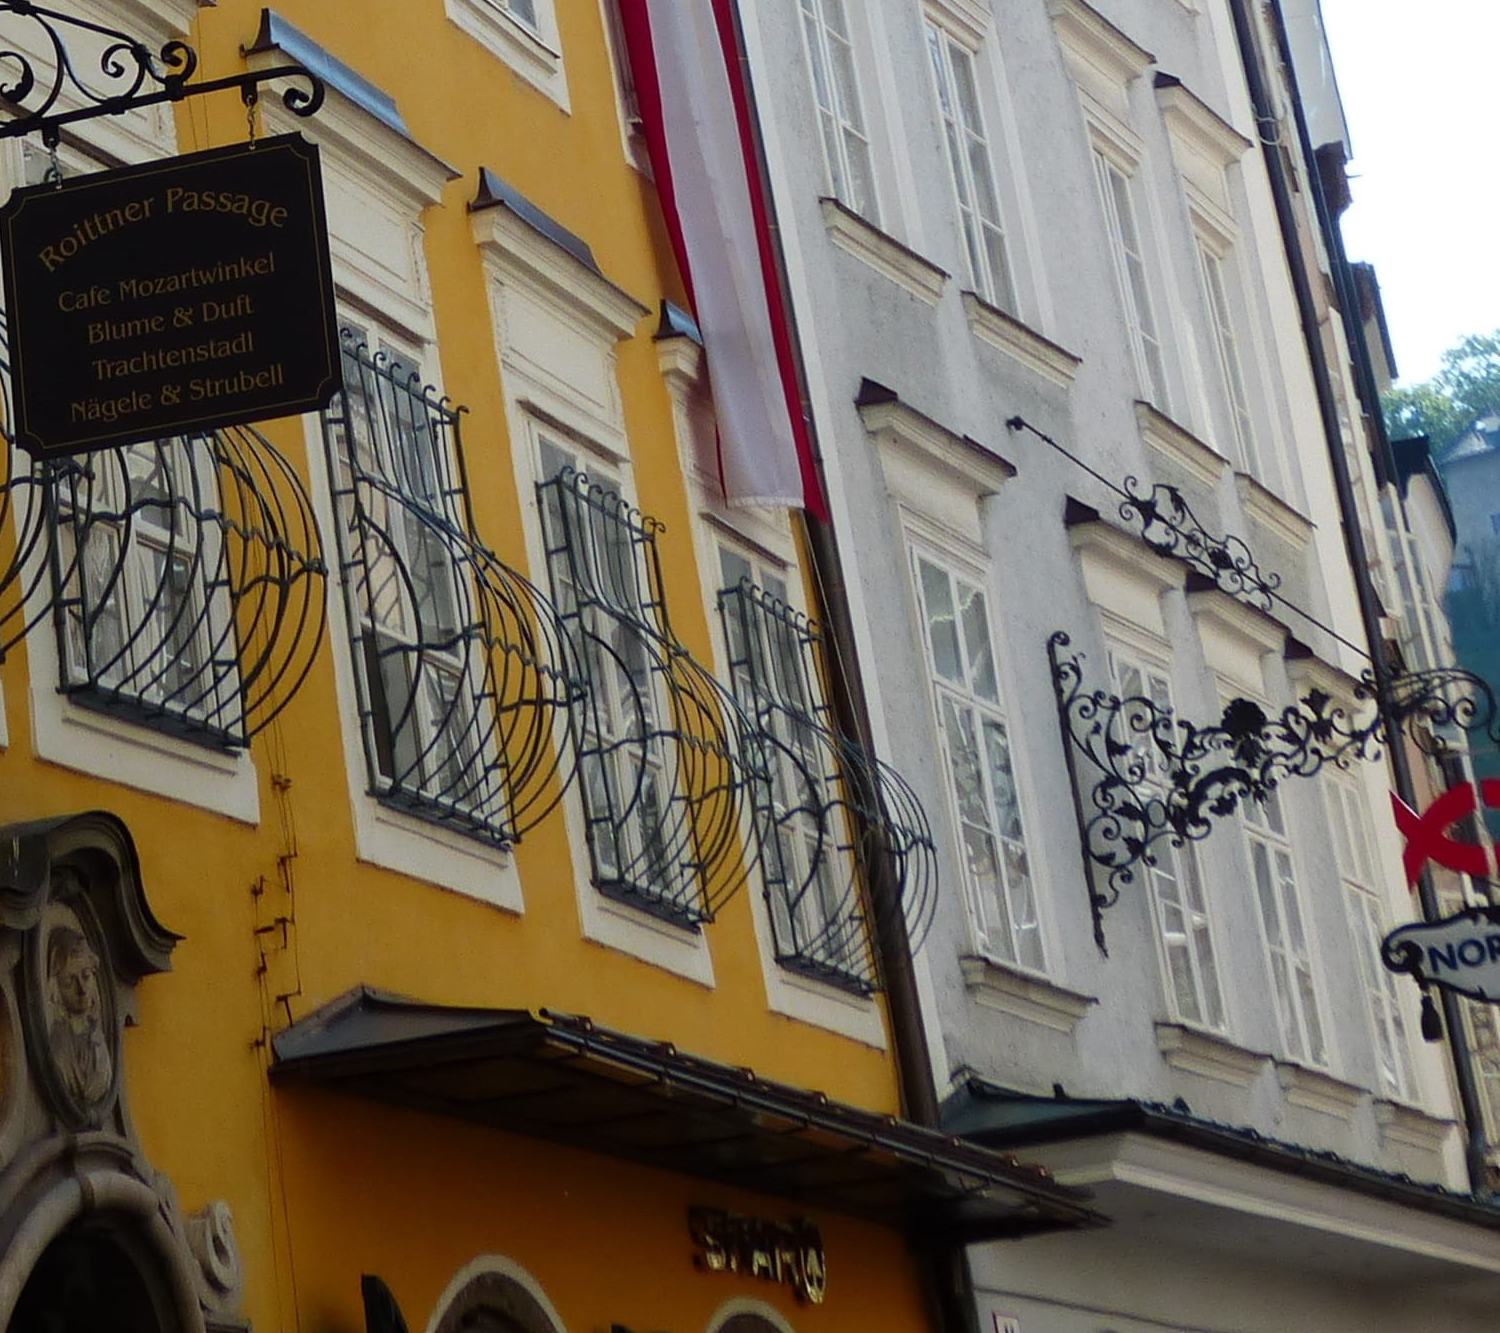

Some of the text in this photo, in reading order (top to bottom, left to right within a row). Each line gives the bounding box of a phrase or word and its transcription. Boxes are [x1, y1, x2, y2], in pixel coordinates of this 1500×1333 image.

[38, 187, 288, 273] Roittner Passage
[58, 252, 276, 312] Cafe Mozartwinkel
[88, 294, 255, 345] Blume & Duft
[92, 331, 255, 381] Trachtenstadl
[70, 364, 284, 423] Nägele & Strubell
